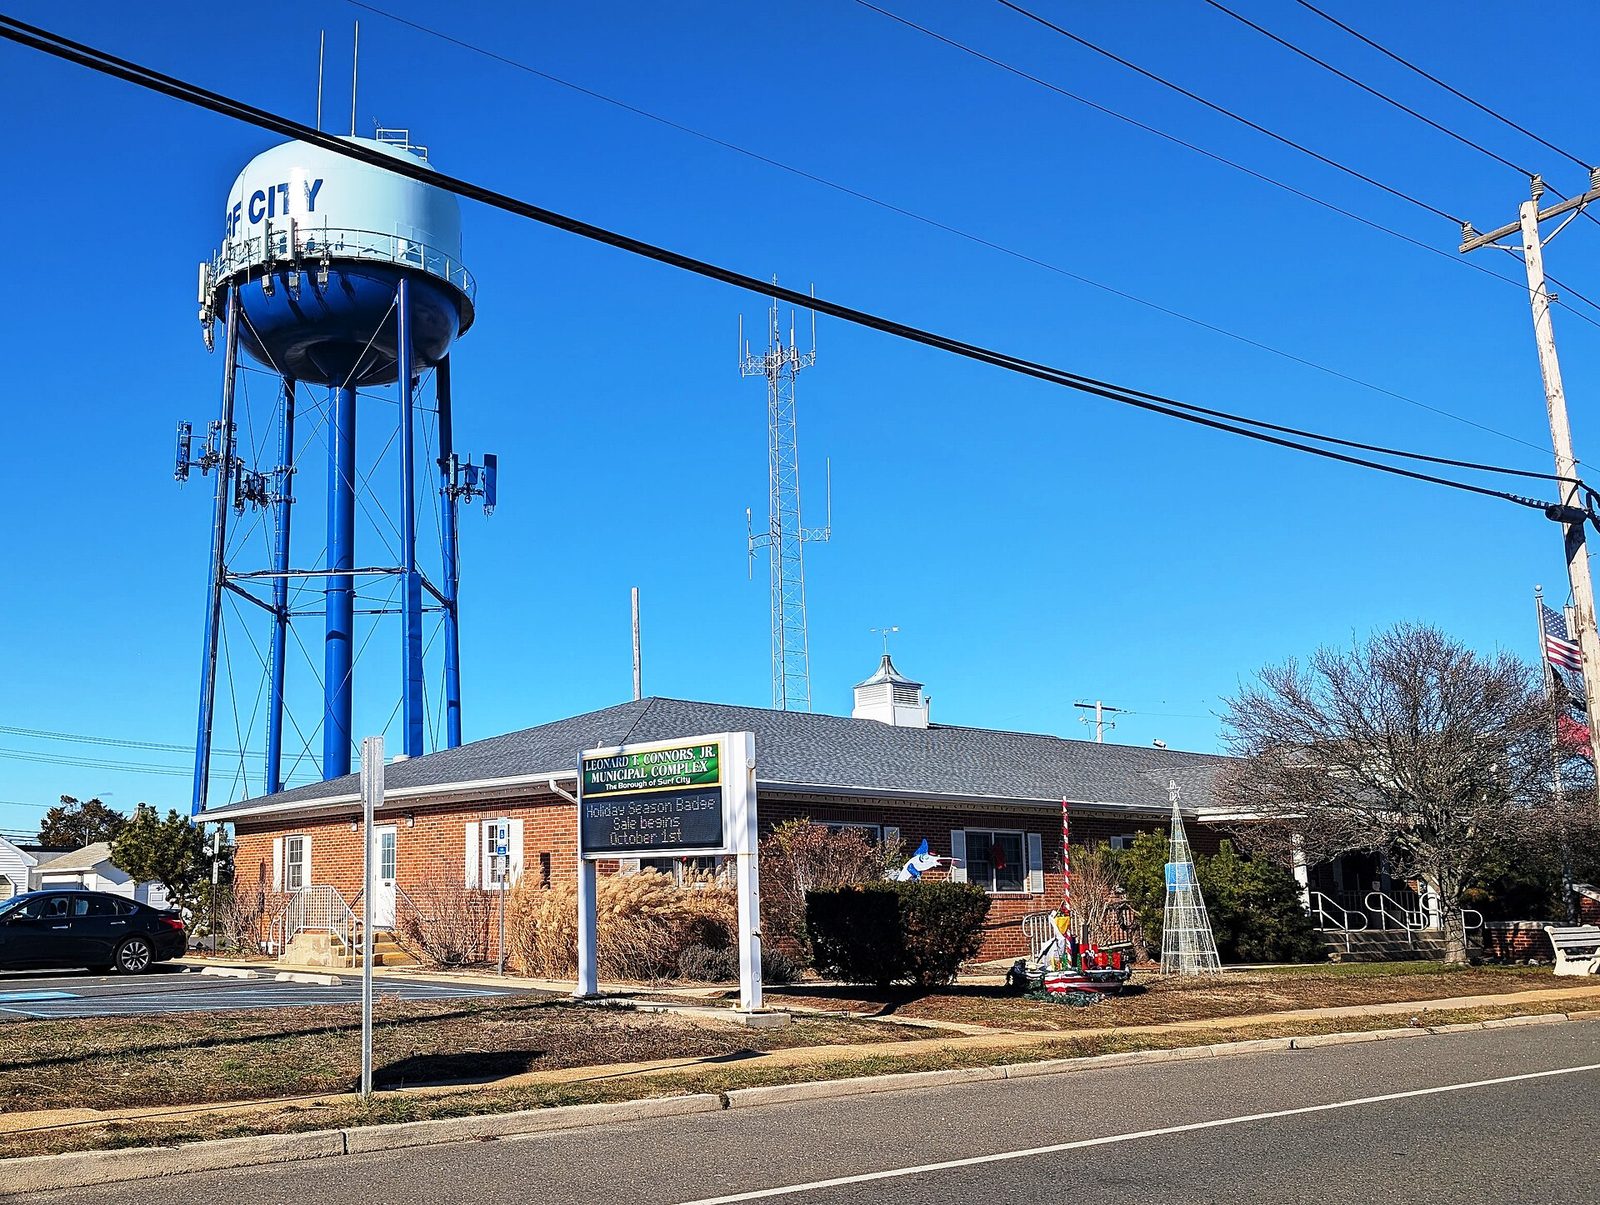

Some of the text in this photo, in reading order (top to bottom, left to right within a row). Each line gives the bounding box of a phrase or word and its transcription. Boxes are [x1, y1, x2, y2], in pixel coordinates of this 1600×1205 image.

[248, 179, 323, 225] CITY
[586, 745, 716, 771] LEONARD T. CONNORS, JR.
[591, 760, 708, 784] MUNICIPAL COMPLEX
[605, 775, 691, 791] The Borough of Surf City
[586, 796, 716, 818] Holiday Season Badge
[613, 815, 681, 831] Sale begins
[609, 828, 684, 846] October 1st
